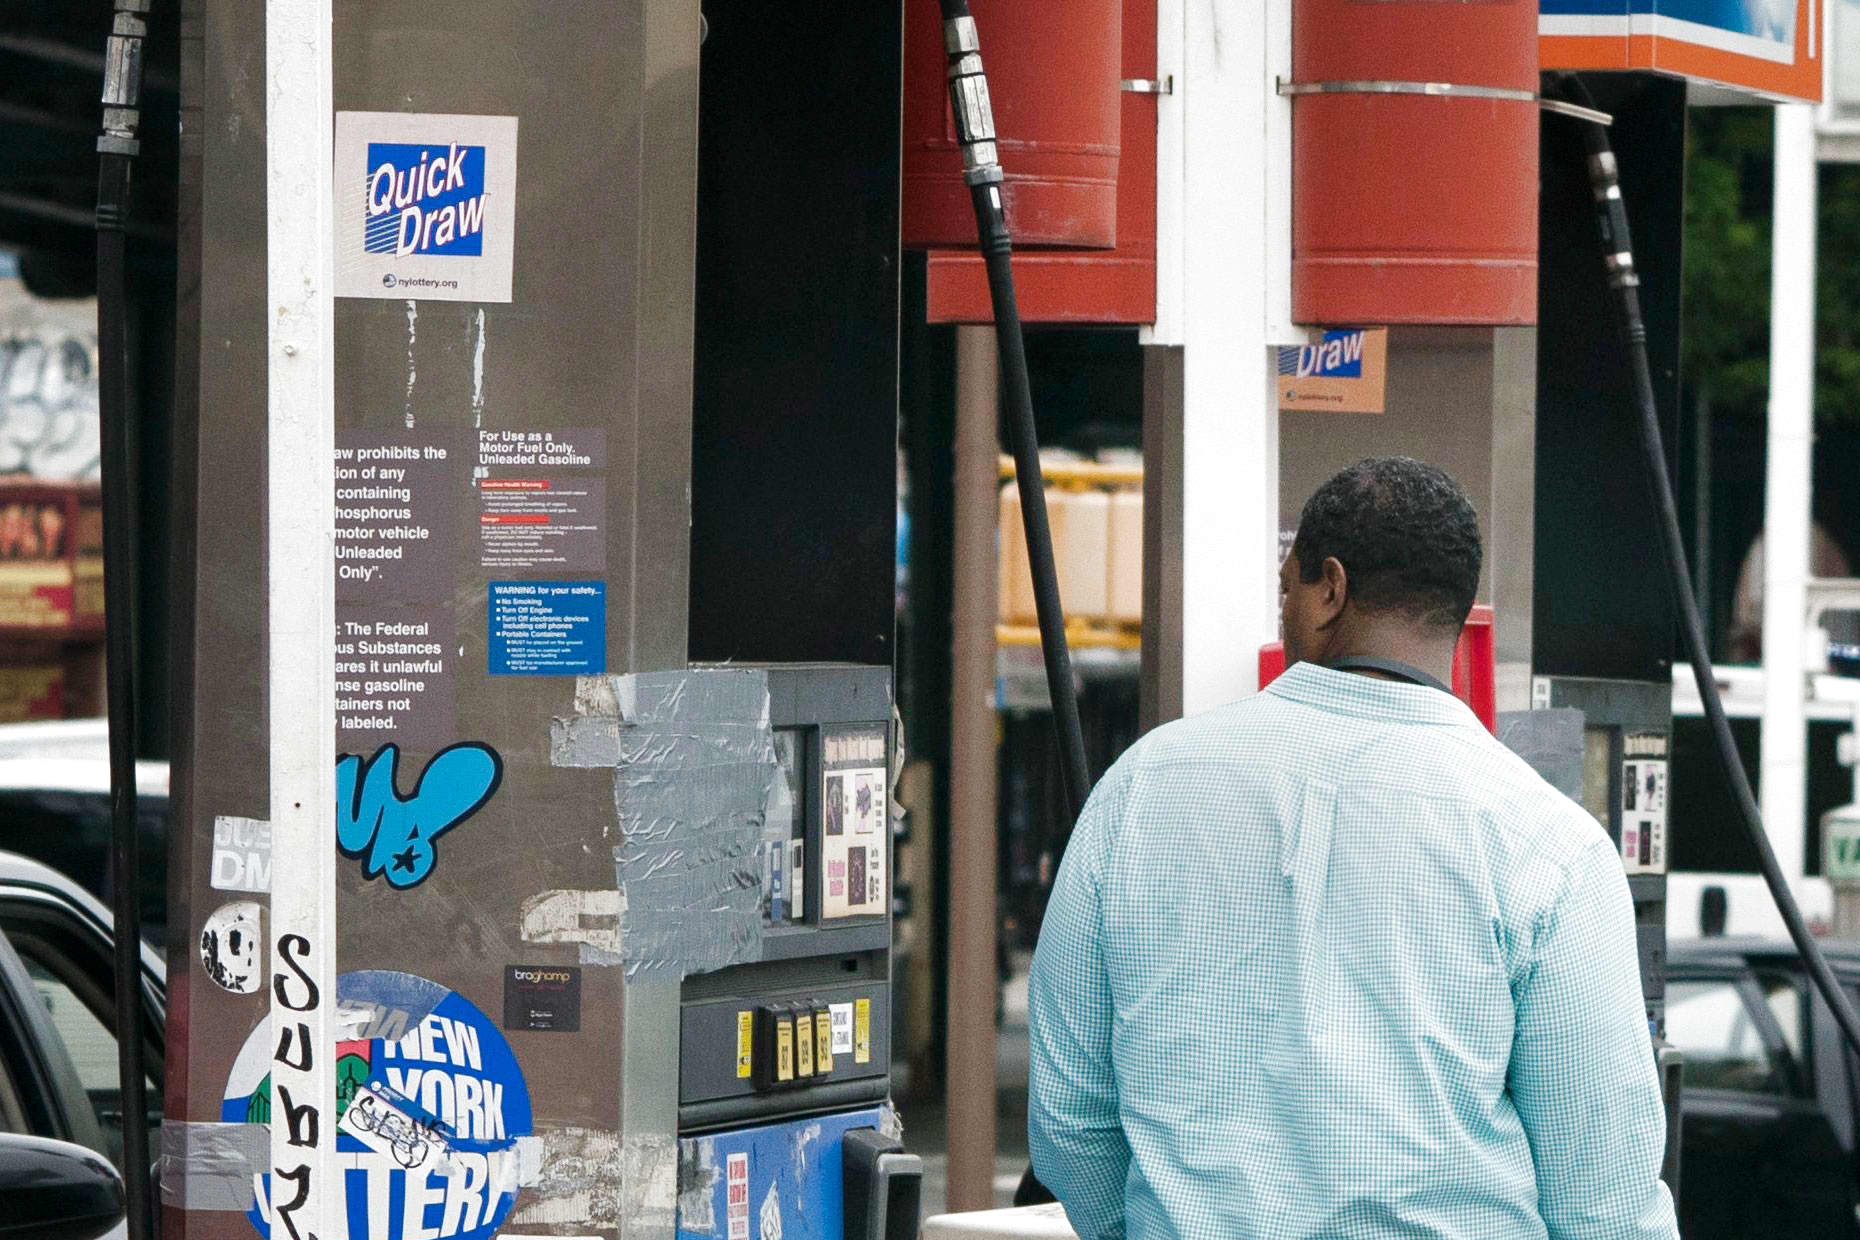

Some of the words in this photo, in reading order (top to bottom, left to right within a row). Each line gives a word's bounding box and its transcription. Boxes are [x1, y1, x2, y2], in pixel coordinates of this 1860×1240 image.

[368, 142, 467, 216] Quick
[396, 193, 487, 259] Draw
[398, 277, 458, 289] nylottery.org
[1296, 330, 1365, 379] Draw
[479, 431, 499, 441] For
[502, 431, 525, 441] Use
[528, 432, 542, 441] as
[545, 432, 553, 441] a
[335, 448, 353, 459] aw
[357, 446, 420, 462] prohibits
[424, 446, 447, 459] the
[479, 442, 514, 453] Motor
[517, 442, 542, 453] Fuel
[546, 442, 576, 456] Only.
[479, 454, 535, 465] Unleaded
[538, 454, 591, 465] Gasoline
[335, 466, 357, 479] ion
[361, 466, 376, 479] of
[379, 468, 405, 482] any
[336, 486, 411, 502] containing
[335, 506, 411, 522] hosphorus
[335, 527, 375, 539] motor
[378, 526, 430, 539] vehicle
[495, 586, 536, 594] WARNING
[538, 586, 550, 594] for
[551, 587, 569, 596] your
[513, 598, 543, 606] Smoking
[529, 607, 553, 615] Engine
[344, 622, 371, 635] The
[375, 622, 429, 635] Federal
[358, 641, 442, 655] Substances
[335, 662, 366, 673] ares
[370, 660, 379, 673] it
[383, 660, 442, 673] unlawful
[335, 680, 361, 692] nse
[364, 679, 425, 695] gasoline
[335, 697, 383, 711] tainers
[387, 698, 411, 711] not
[341, 716, 397, 729] labeled.
[386, 1066, 506, 1140] YORK
